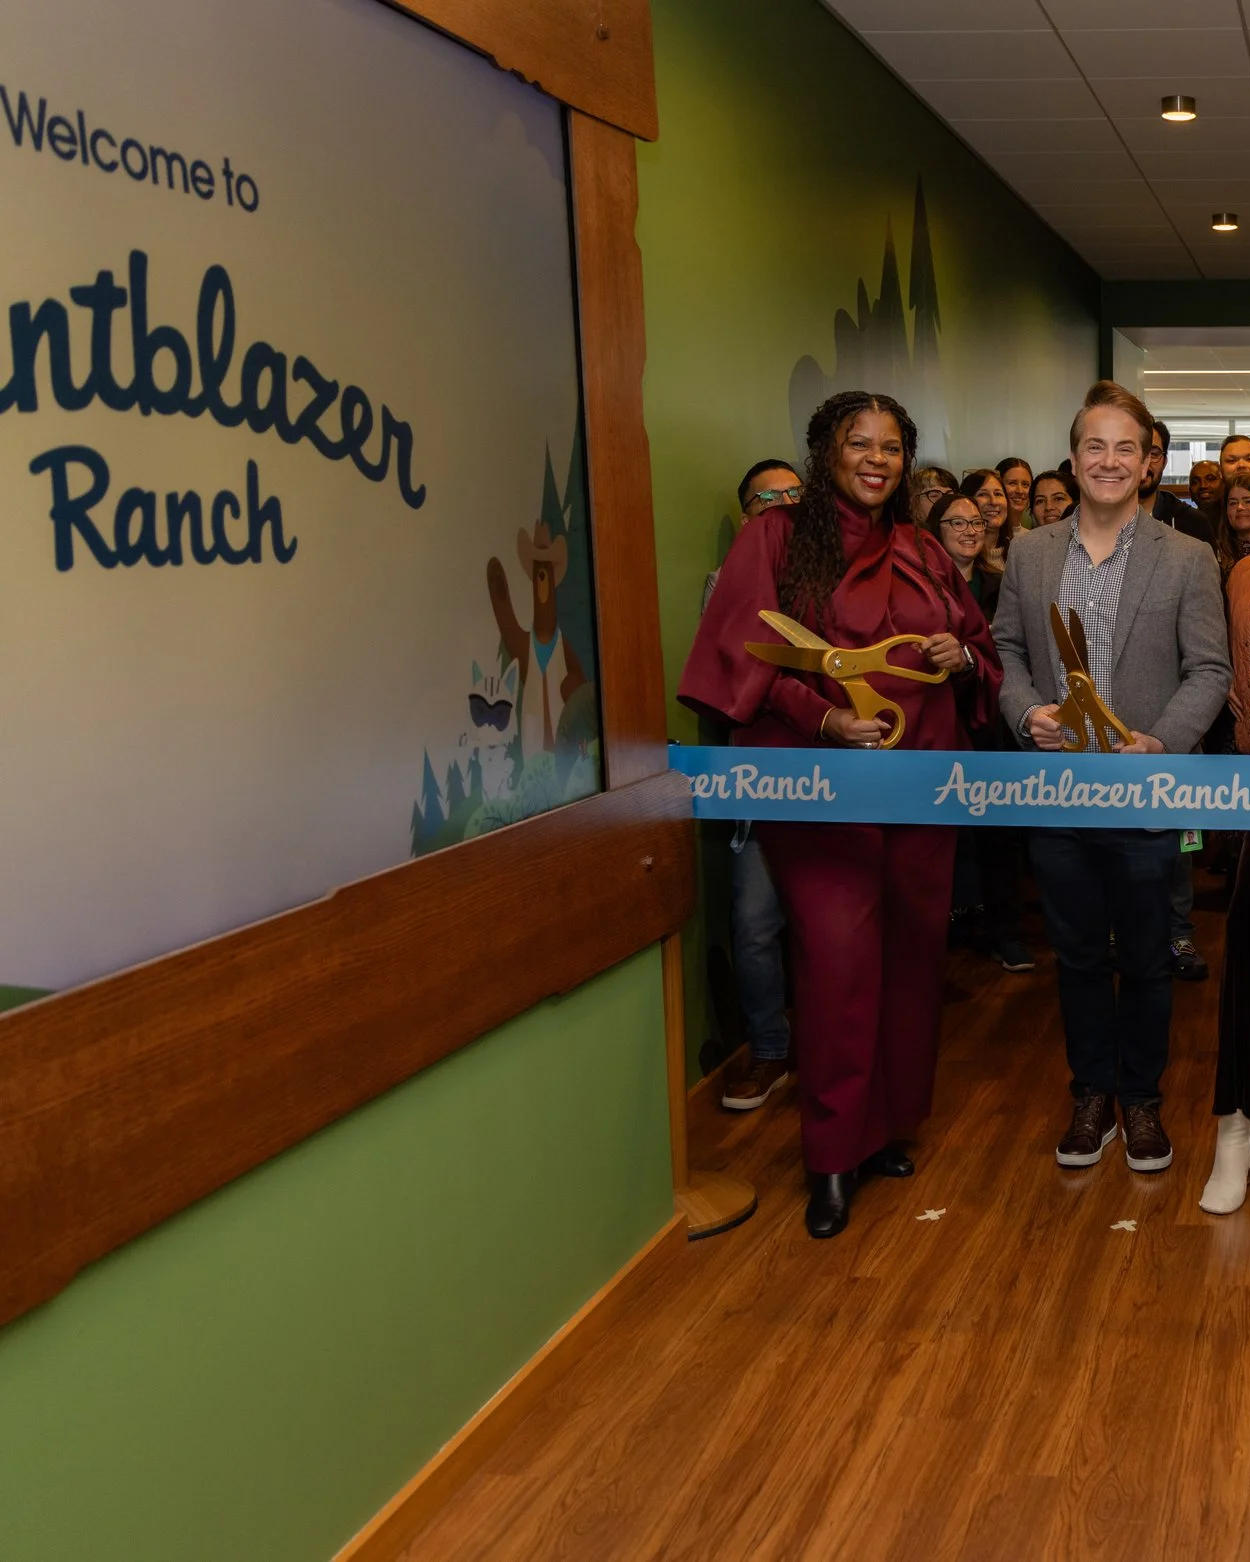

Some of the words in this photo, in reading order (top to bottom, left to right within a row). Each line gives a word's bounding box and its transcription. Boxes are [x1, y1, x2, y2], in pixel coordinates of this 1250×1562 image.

[0, 84, 215, 201] Welcome
[221, 156, 260, 213] to
[0, 249, 427, 511] ntblazer
[28, 445, 298, 572] Ranch
[730, 763, 837, 802] Ranch
[933, 761, 1147, 817] Agentblazer
